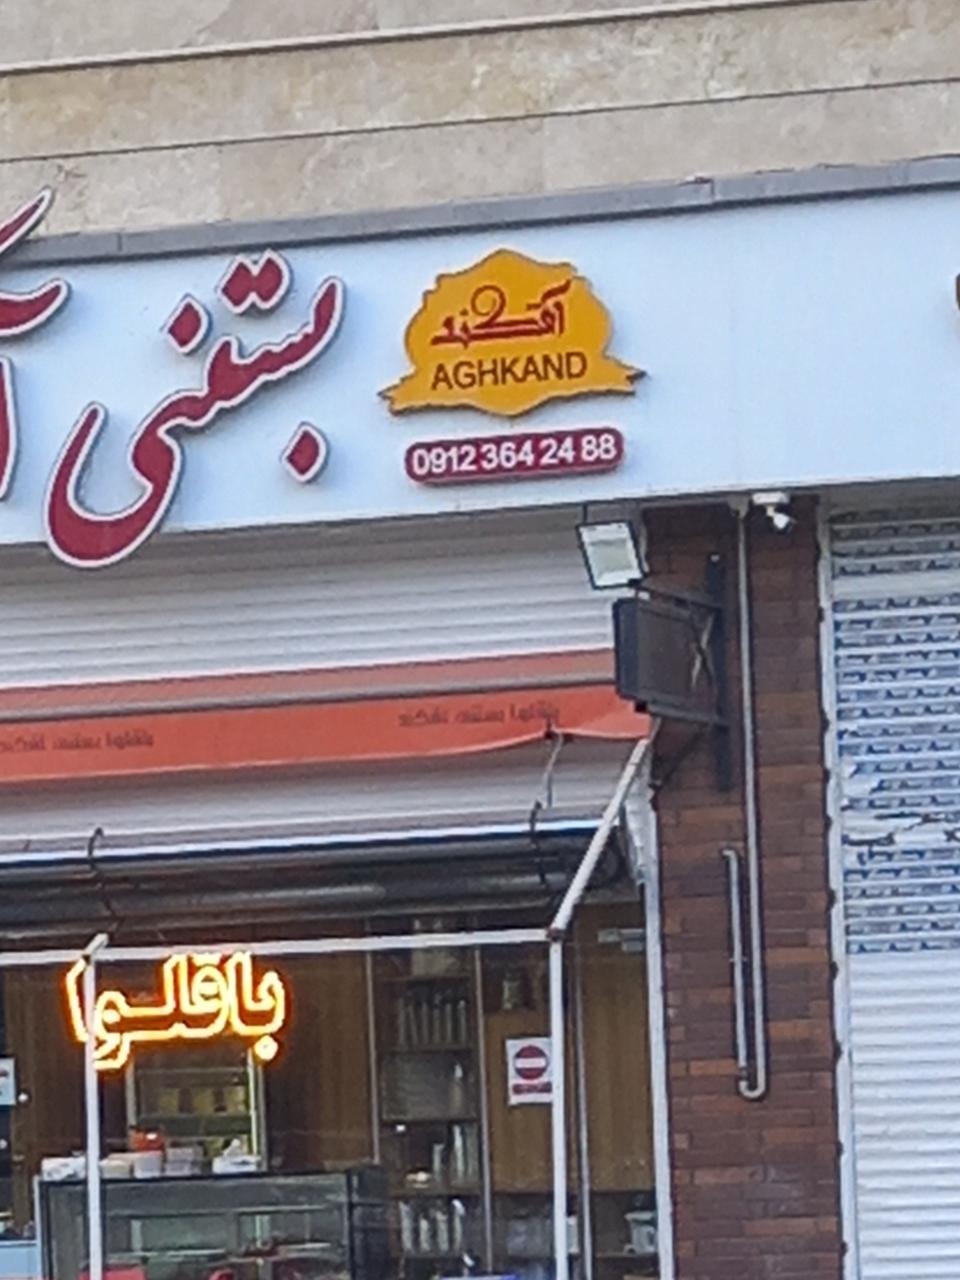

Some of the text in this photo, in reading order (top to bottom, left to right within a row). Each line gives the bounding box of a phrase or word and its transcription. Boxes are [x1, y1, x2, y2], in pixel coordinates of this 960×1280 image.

[44, 248, 345, 568] بستنی
[431, 351, 588, 391] AGHKAND
[412, 433, 617, 476] 0912 364 24 88
[65, 950, 286, 1070] باقلوا
